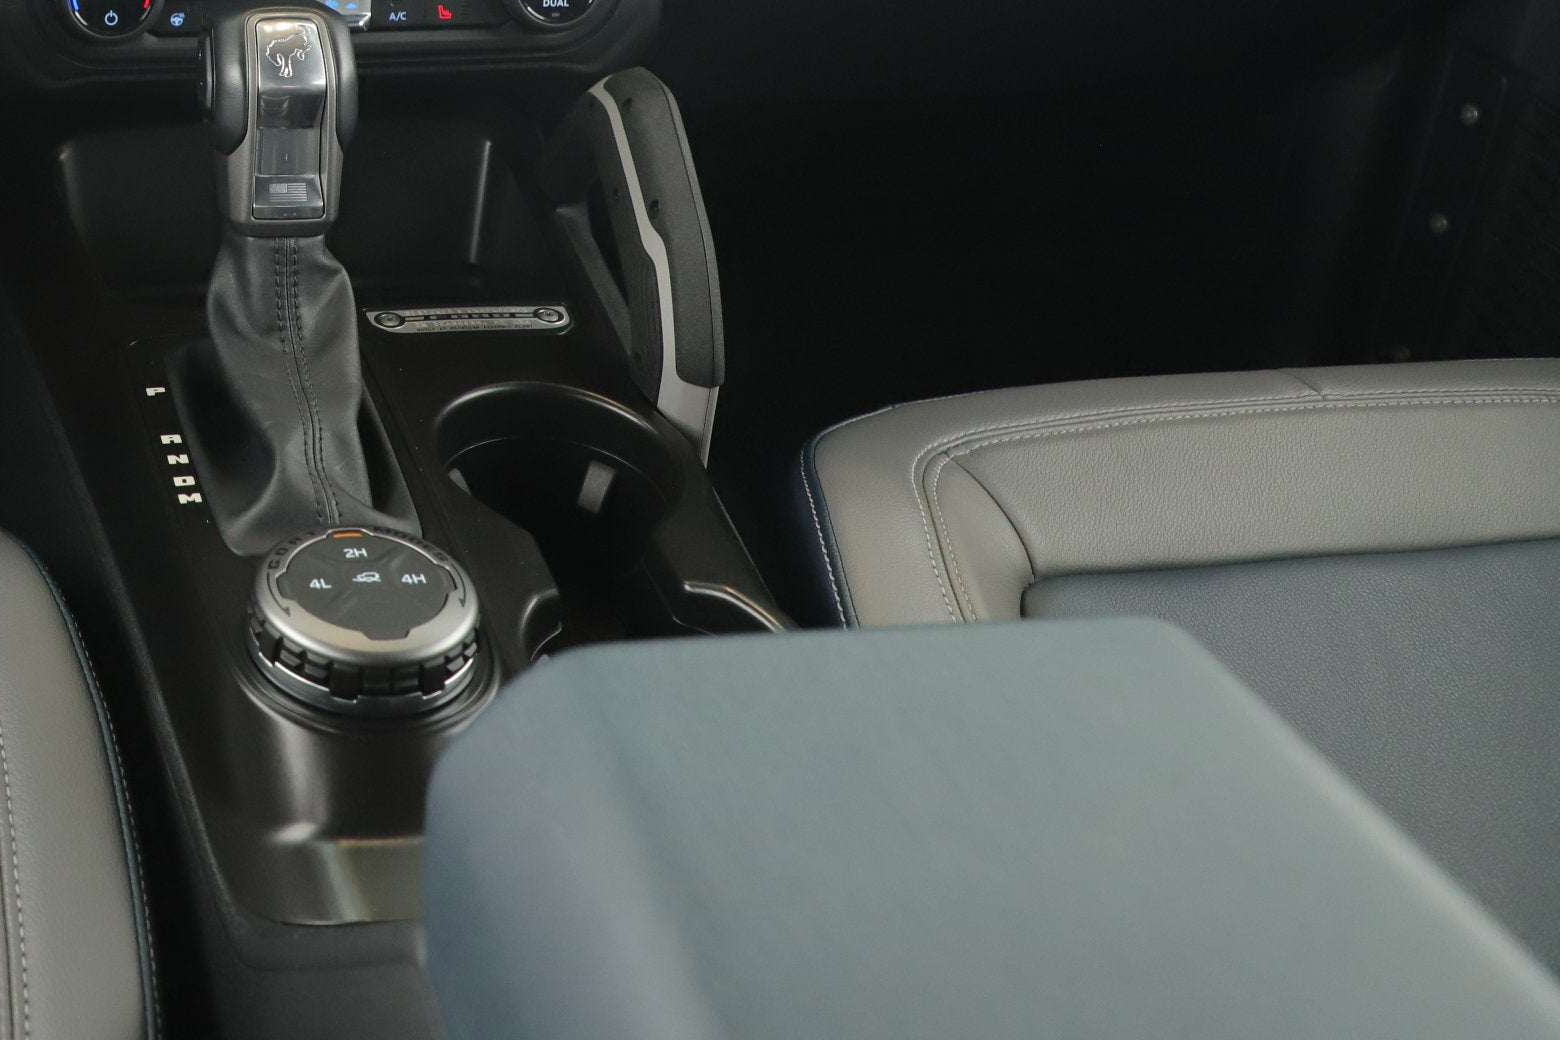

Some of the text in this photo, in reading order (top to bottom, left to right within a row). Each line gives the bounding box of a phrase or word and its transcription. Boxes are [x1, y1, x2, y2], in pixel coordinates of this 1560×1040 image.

[389, 11, 407, 21] A/C
[146, 387, 166, 396] P
[167, 454, 189, 464] N
[173, 476, 195, 487] D
[178, 492, 202, 504] M
[343, 548, 368, 558] 2H
[309, 578, 332, 589] 4L
[401, 573, 427, 584] 4H
